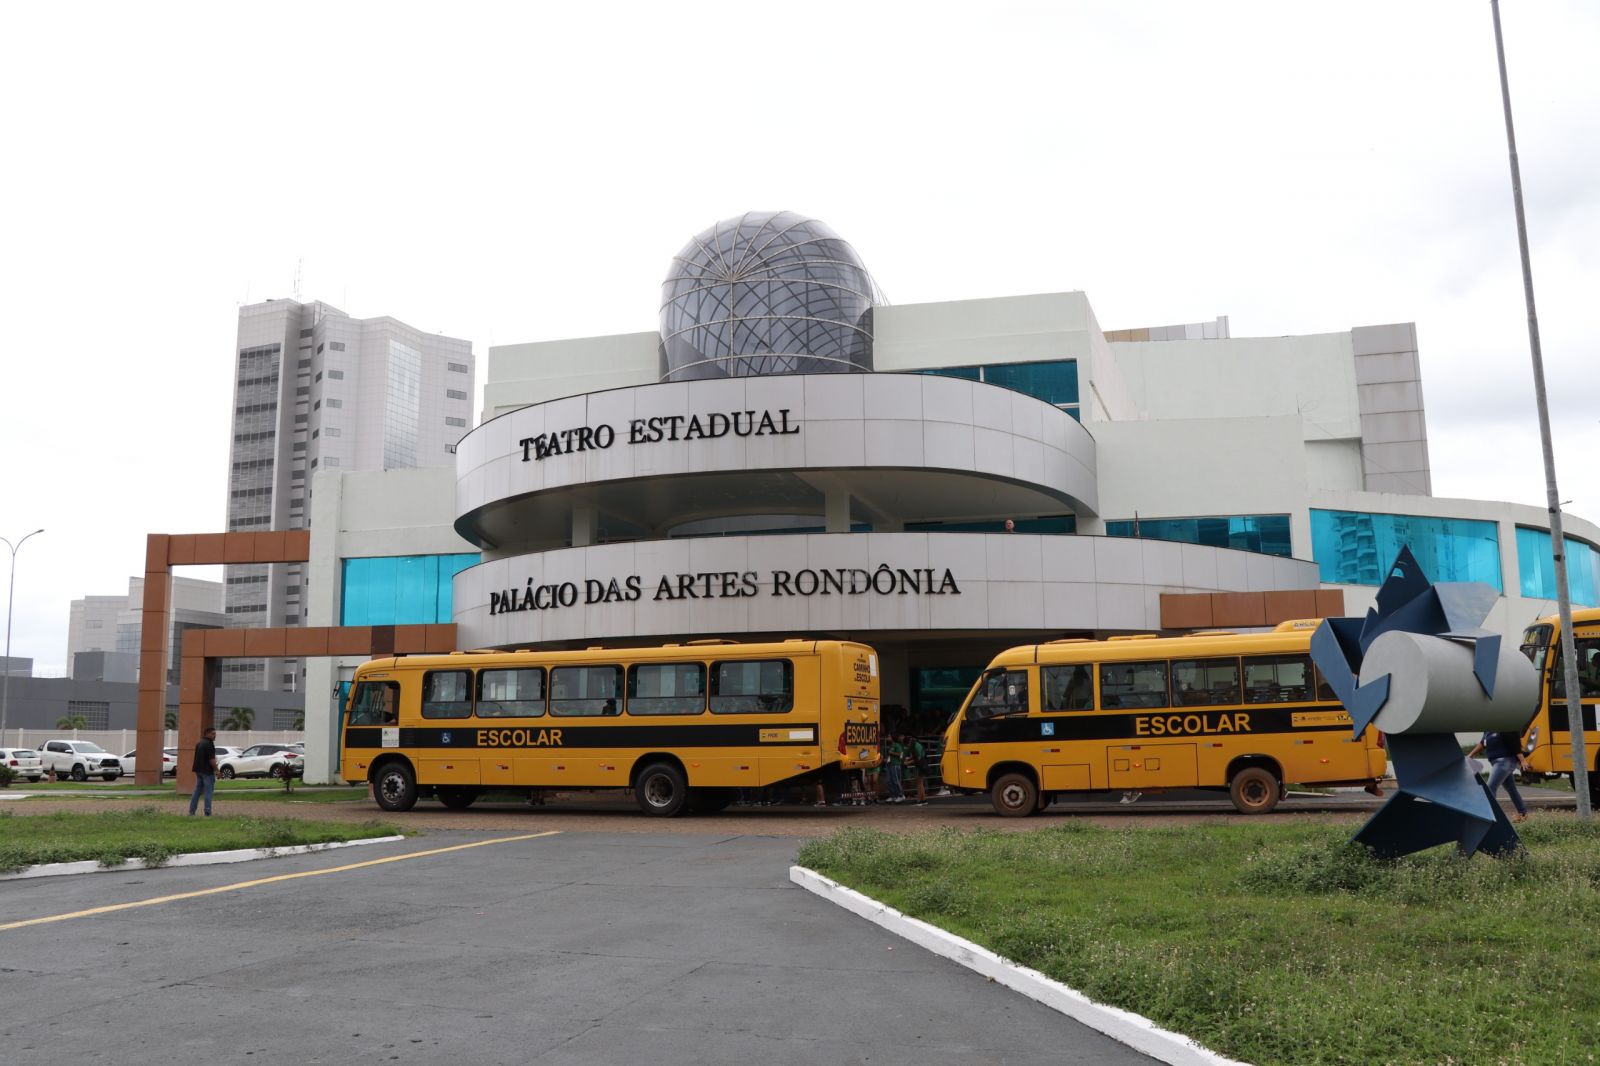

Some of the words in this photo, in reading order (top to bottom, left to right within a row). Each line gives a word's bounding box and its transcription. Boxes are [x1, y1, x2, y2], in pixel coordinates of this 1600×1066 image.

[519, 423, 615, 462] TEATRO
[628, 409, 800, 444] ESTADUAL
[489, 577, 578, 615] PALÁCIO
[584, 575, 642, 605] DAS
[653, 570, 759, 600] ARTES
[771, 563, 961, 597] RONDÔNIA
[847, 726, 877, 743] ESCOLAR
[1135, 713, 1251, 736] ESCOLAR
[476, 729, 564, 746] ESCOLAR
